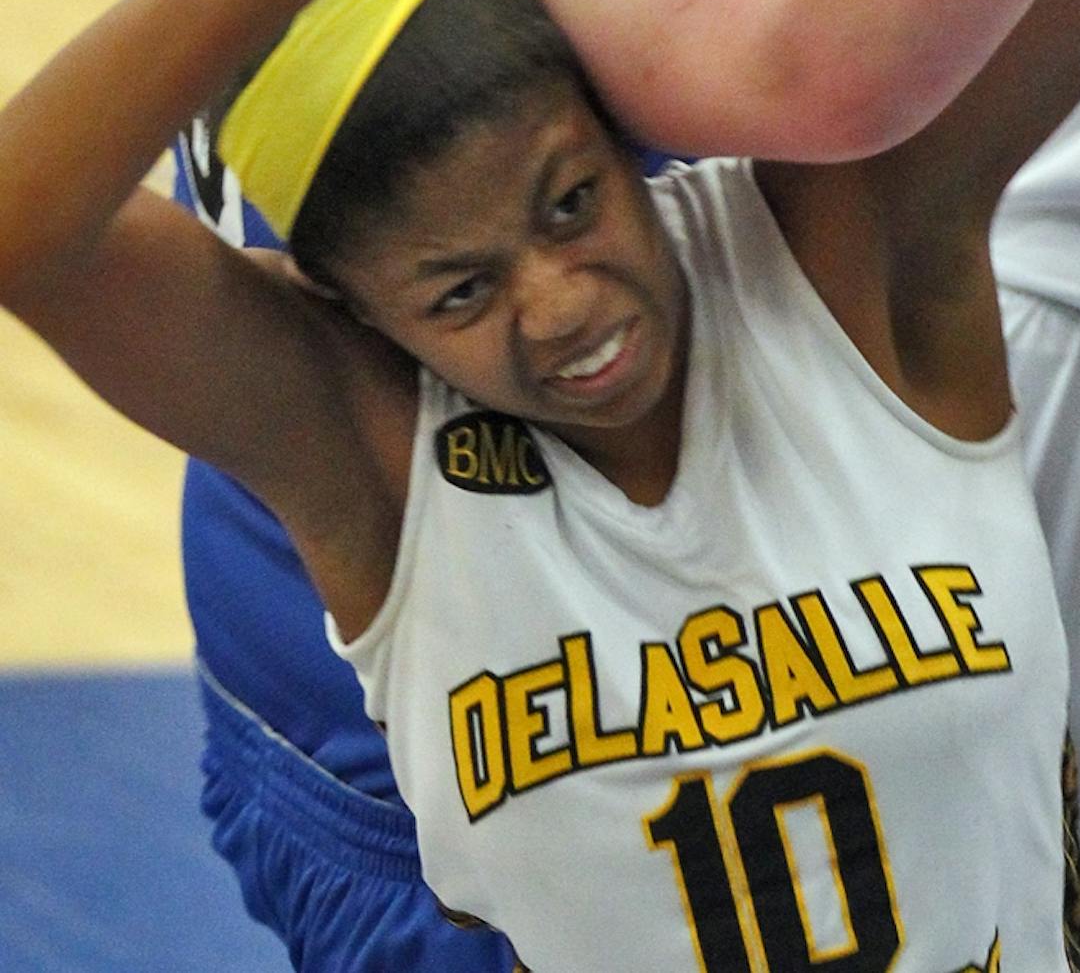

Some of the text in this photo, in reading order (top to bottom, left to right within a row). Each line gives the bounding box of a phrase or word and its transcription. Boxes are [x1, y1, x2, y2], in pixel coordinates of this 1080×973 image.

[447, 420, 544, 485] BMC
[448, 564, 1012, 824] DELASALLE
[641, 745, 906, 973] 10
